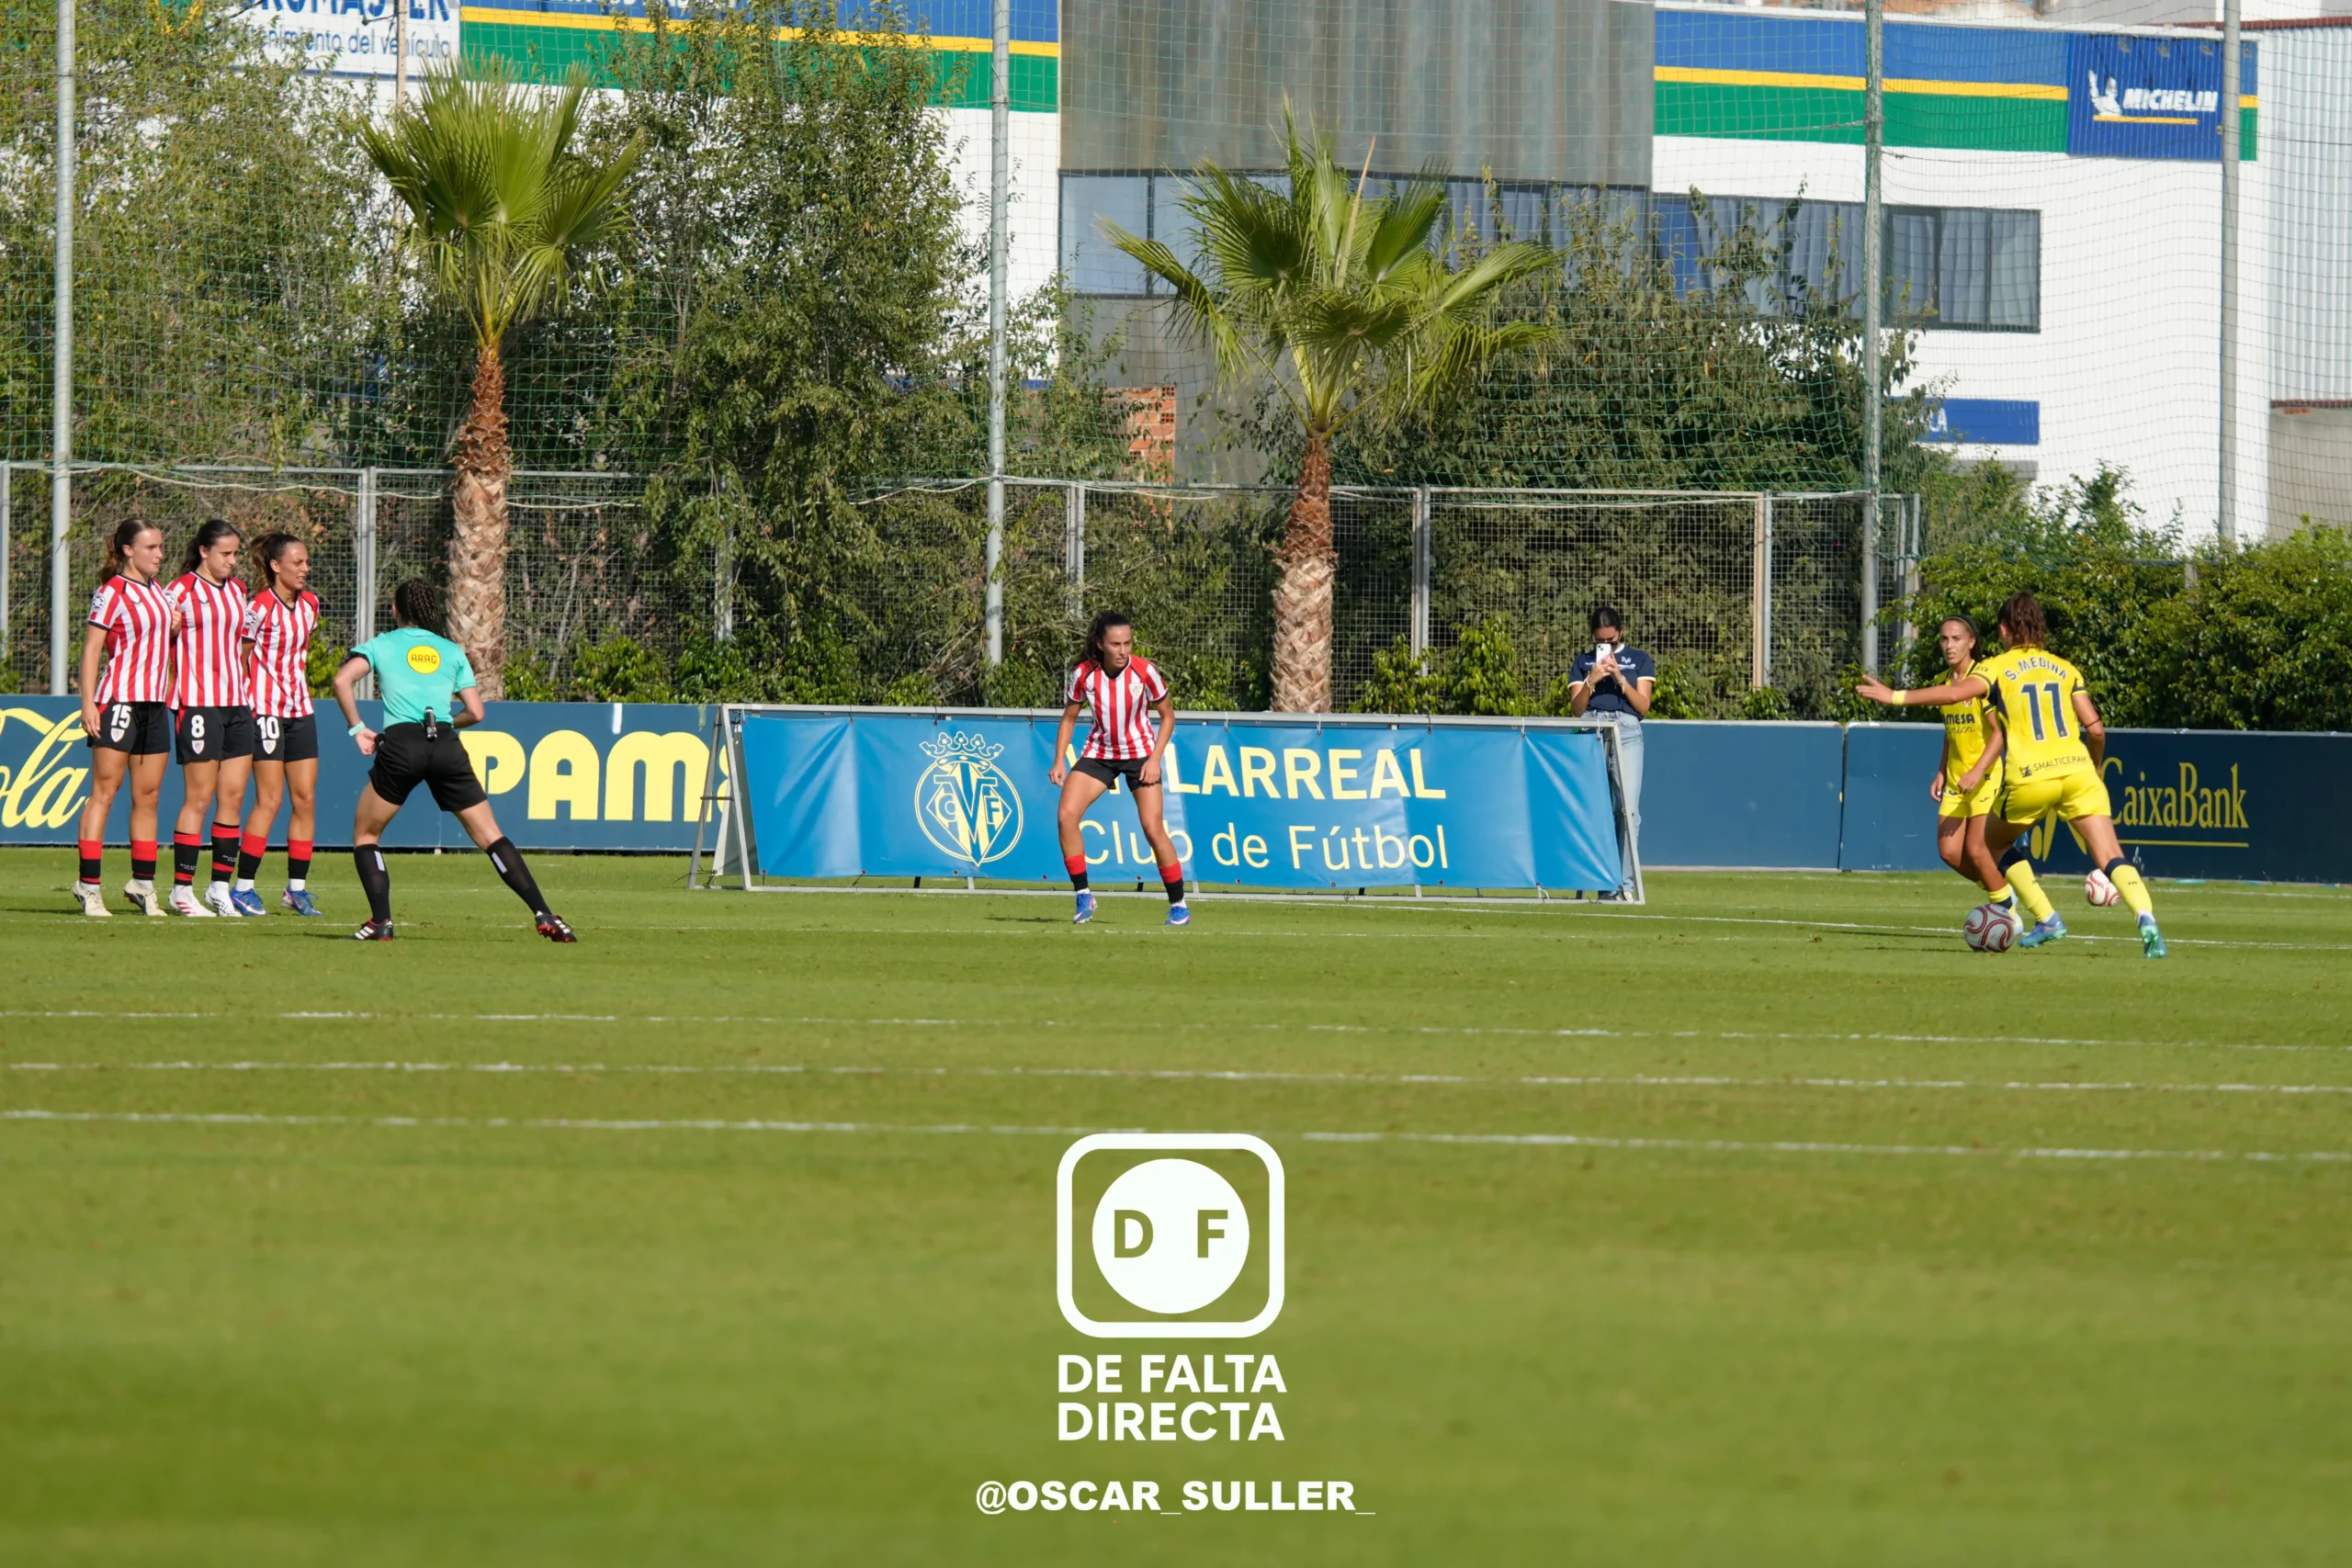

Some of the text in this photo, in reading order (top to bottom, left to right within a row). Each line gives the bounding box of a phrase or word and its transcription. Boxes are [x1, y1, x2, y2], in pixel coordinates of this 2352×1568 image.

[348, 28, 375, 54] del
[2122, 88, 2218, 112] MICHELIN
[411, 653, 437, 664] ARAG
[2005, 657, 2067, 681] S.MEDINA
[110, 704, 132, 728] 15
[2020, 682, 2068, 742] 11
[191, 715, 205, 738] 8
[256, 716, 280, 739] 10
[1065, 742, 1446, 799] LARREAL
[1079, 819, 1448, 871] Club de Fútbol
